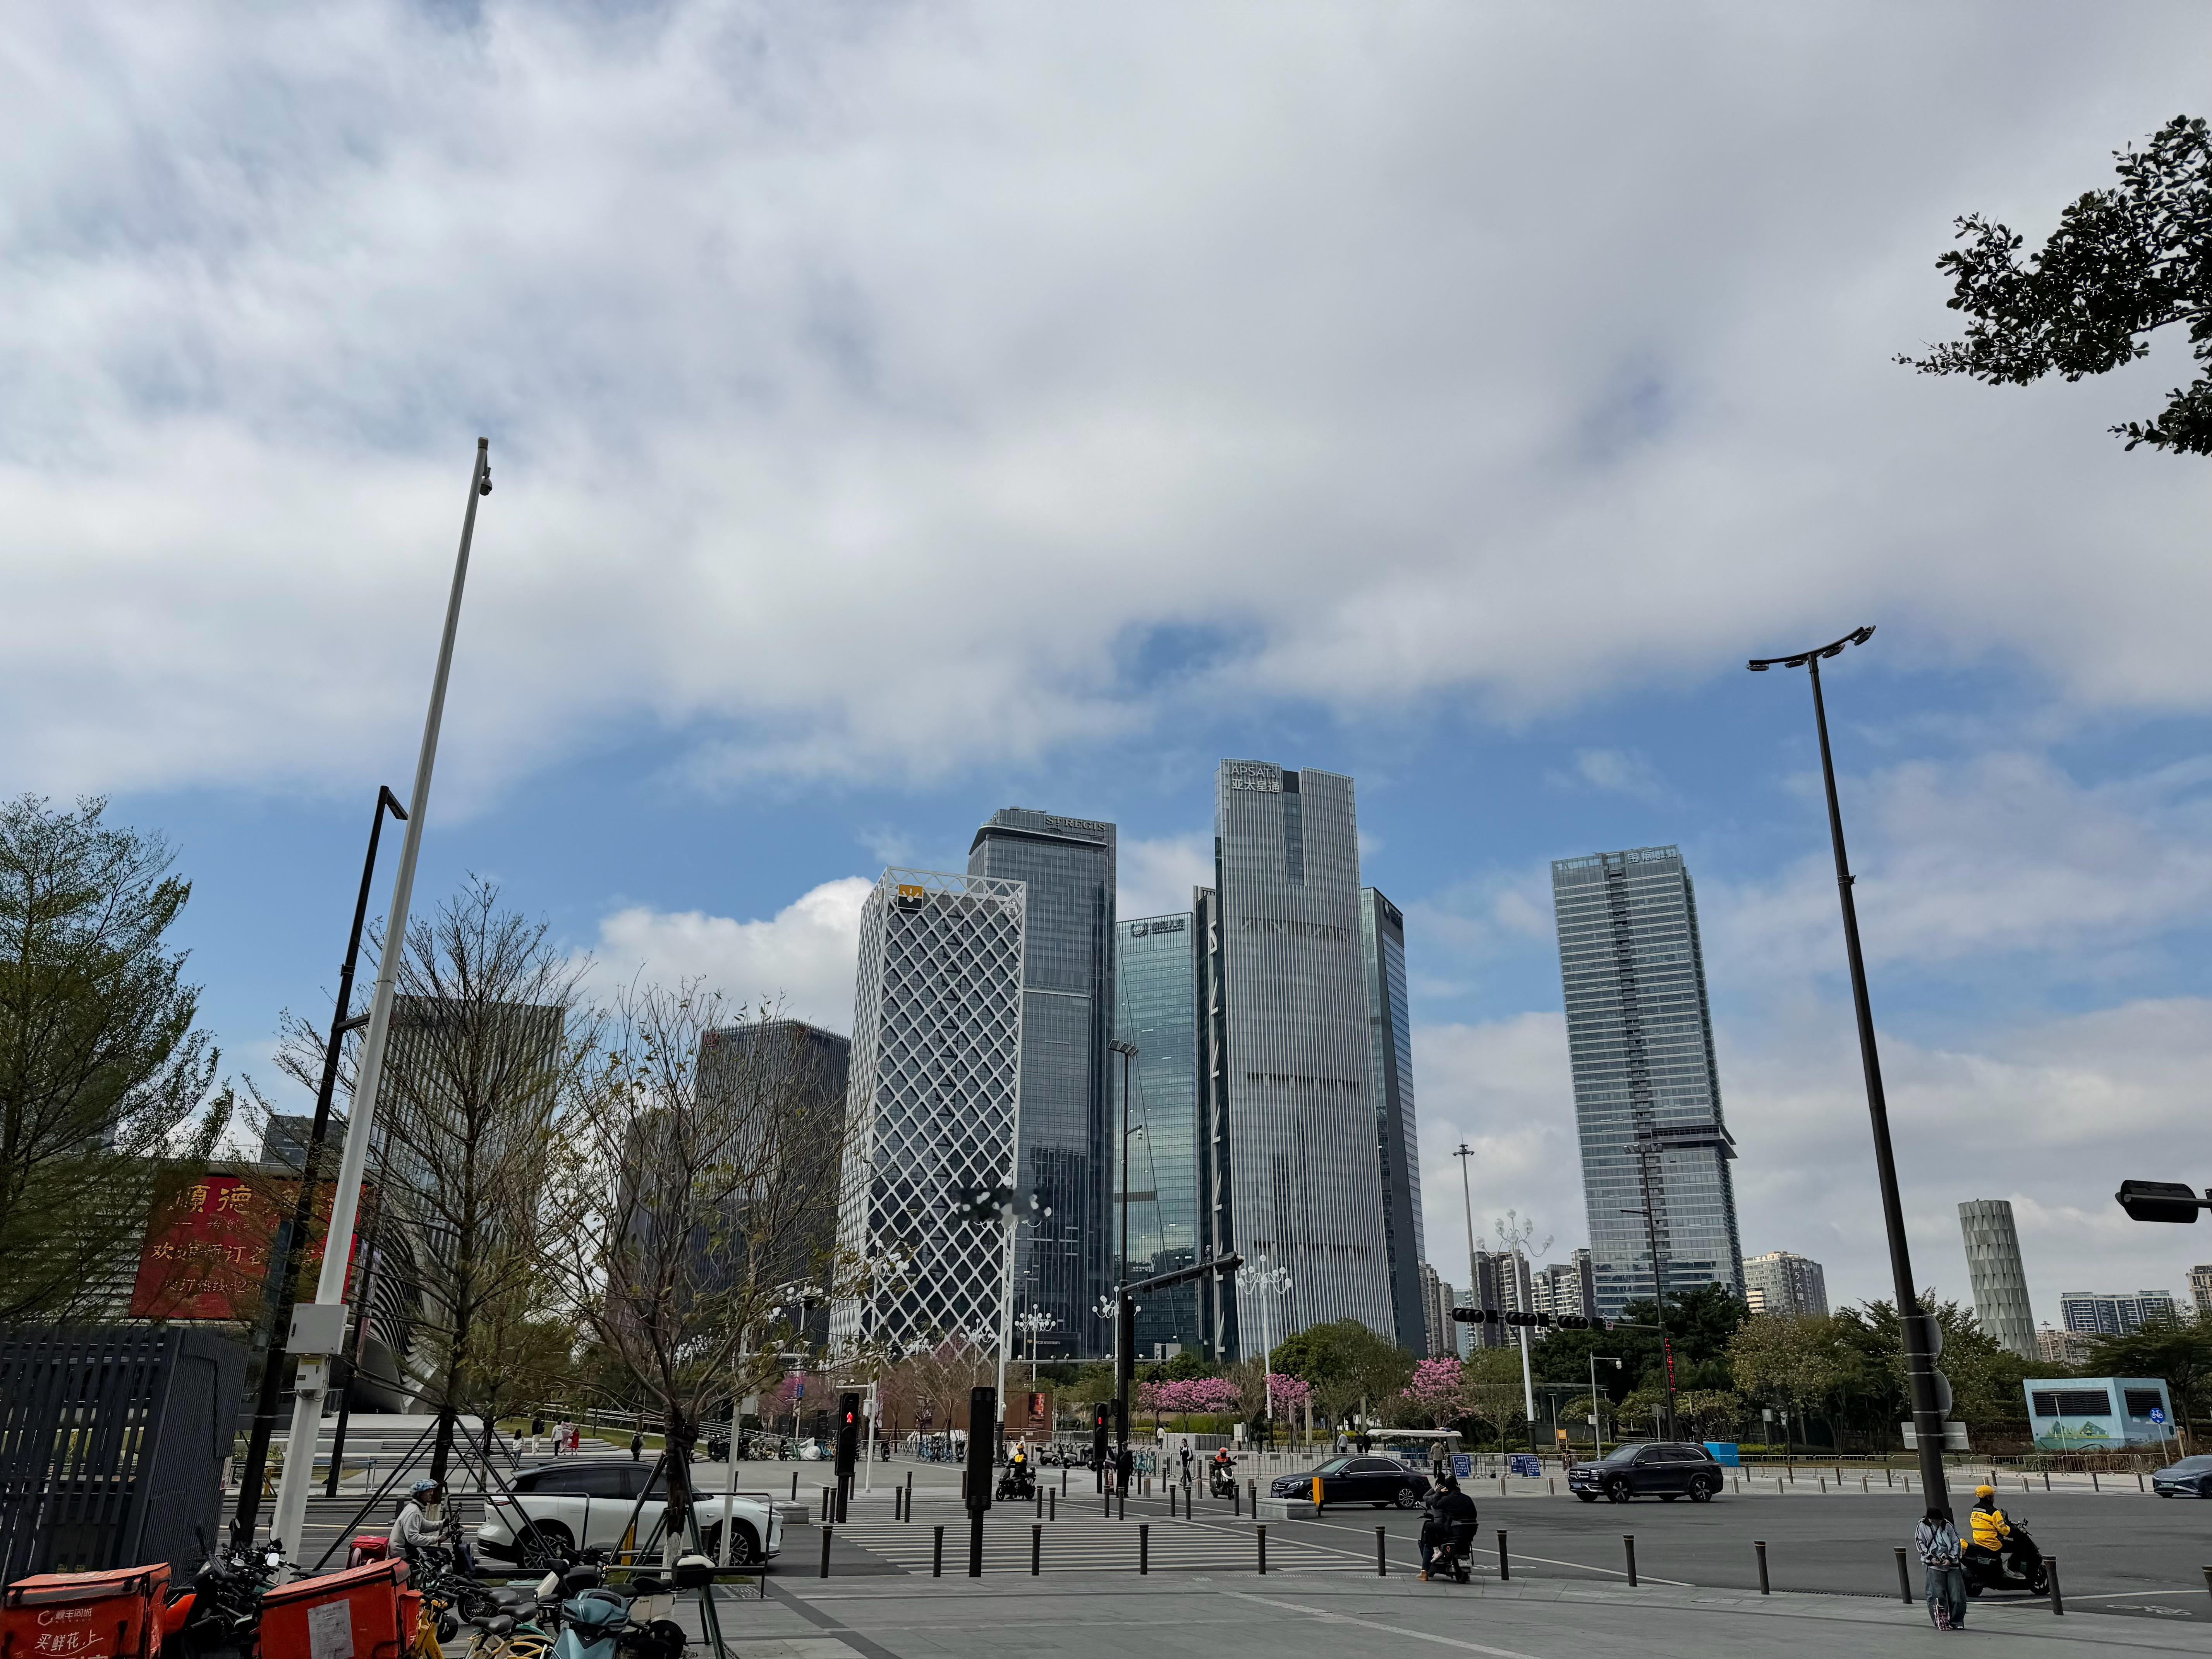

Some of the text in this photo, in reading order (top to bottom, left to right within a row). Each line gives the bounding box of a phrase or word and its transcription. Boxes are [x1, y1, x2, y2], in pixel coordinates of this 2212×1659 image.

[1232, 778, 1280, 793] 亚太星通
[1064, 818, 1106, 831] REGIS
